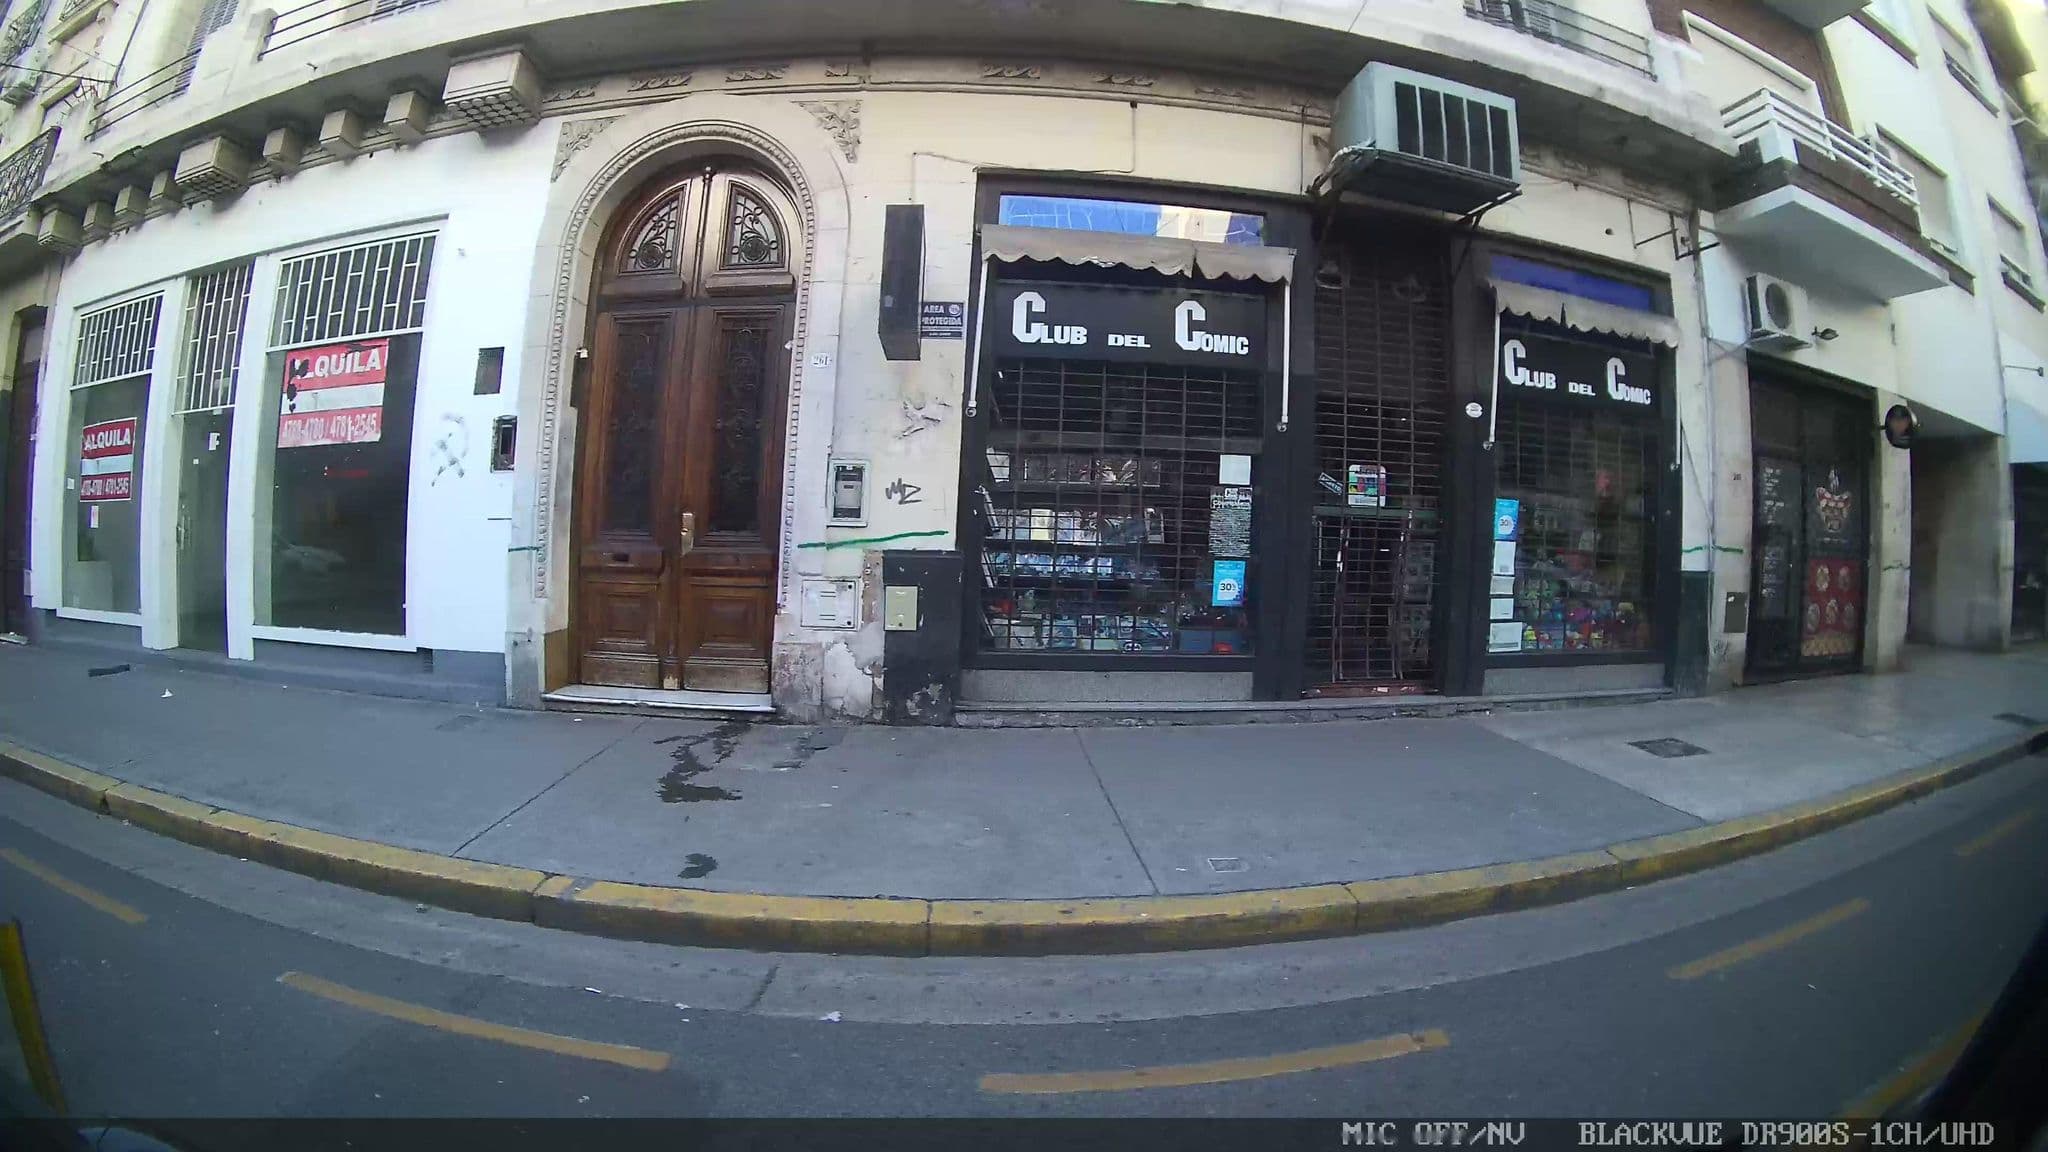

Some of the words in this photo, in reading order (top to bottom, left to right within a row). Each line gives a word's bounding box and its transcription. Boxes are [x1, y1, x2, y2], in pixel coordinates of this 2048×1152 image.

[923, 304, 945, 314] AREA
[1012, 291, 1088, 345] CLUB
[1108, 334, 1151, 348] DEL
[1174, 300, 1249, 356] COMIC
[1504, 339, 1556, 390] CLUB
[1568, 382, 1596, 396] DEL
[84, 428, 131, 451] ALQUILA
